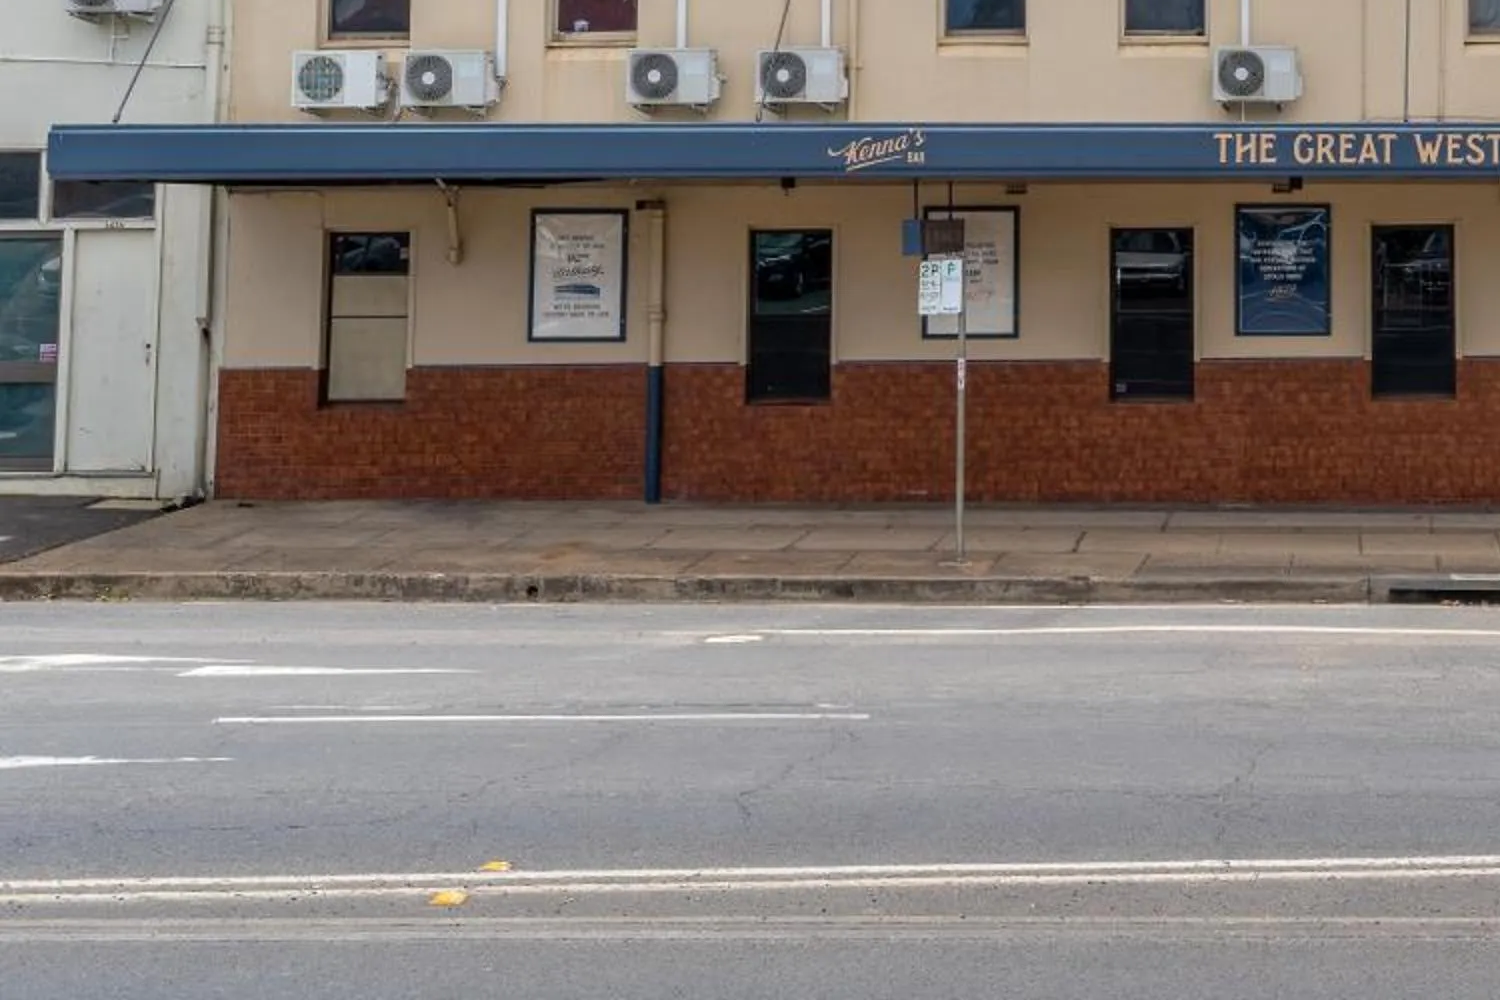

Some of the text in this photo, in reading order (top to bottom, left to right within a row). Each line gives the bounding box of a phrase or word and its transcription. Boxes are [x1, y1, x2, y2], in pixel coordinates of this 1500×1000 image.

[827, 128, 924, 166] Kenna's
[1214, 133, 1277, 164] THE
[1293, 133, 1398, 165] GREAT
[921, 263, 939, 277] 2P
